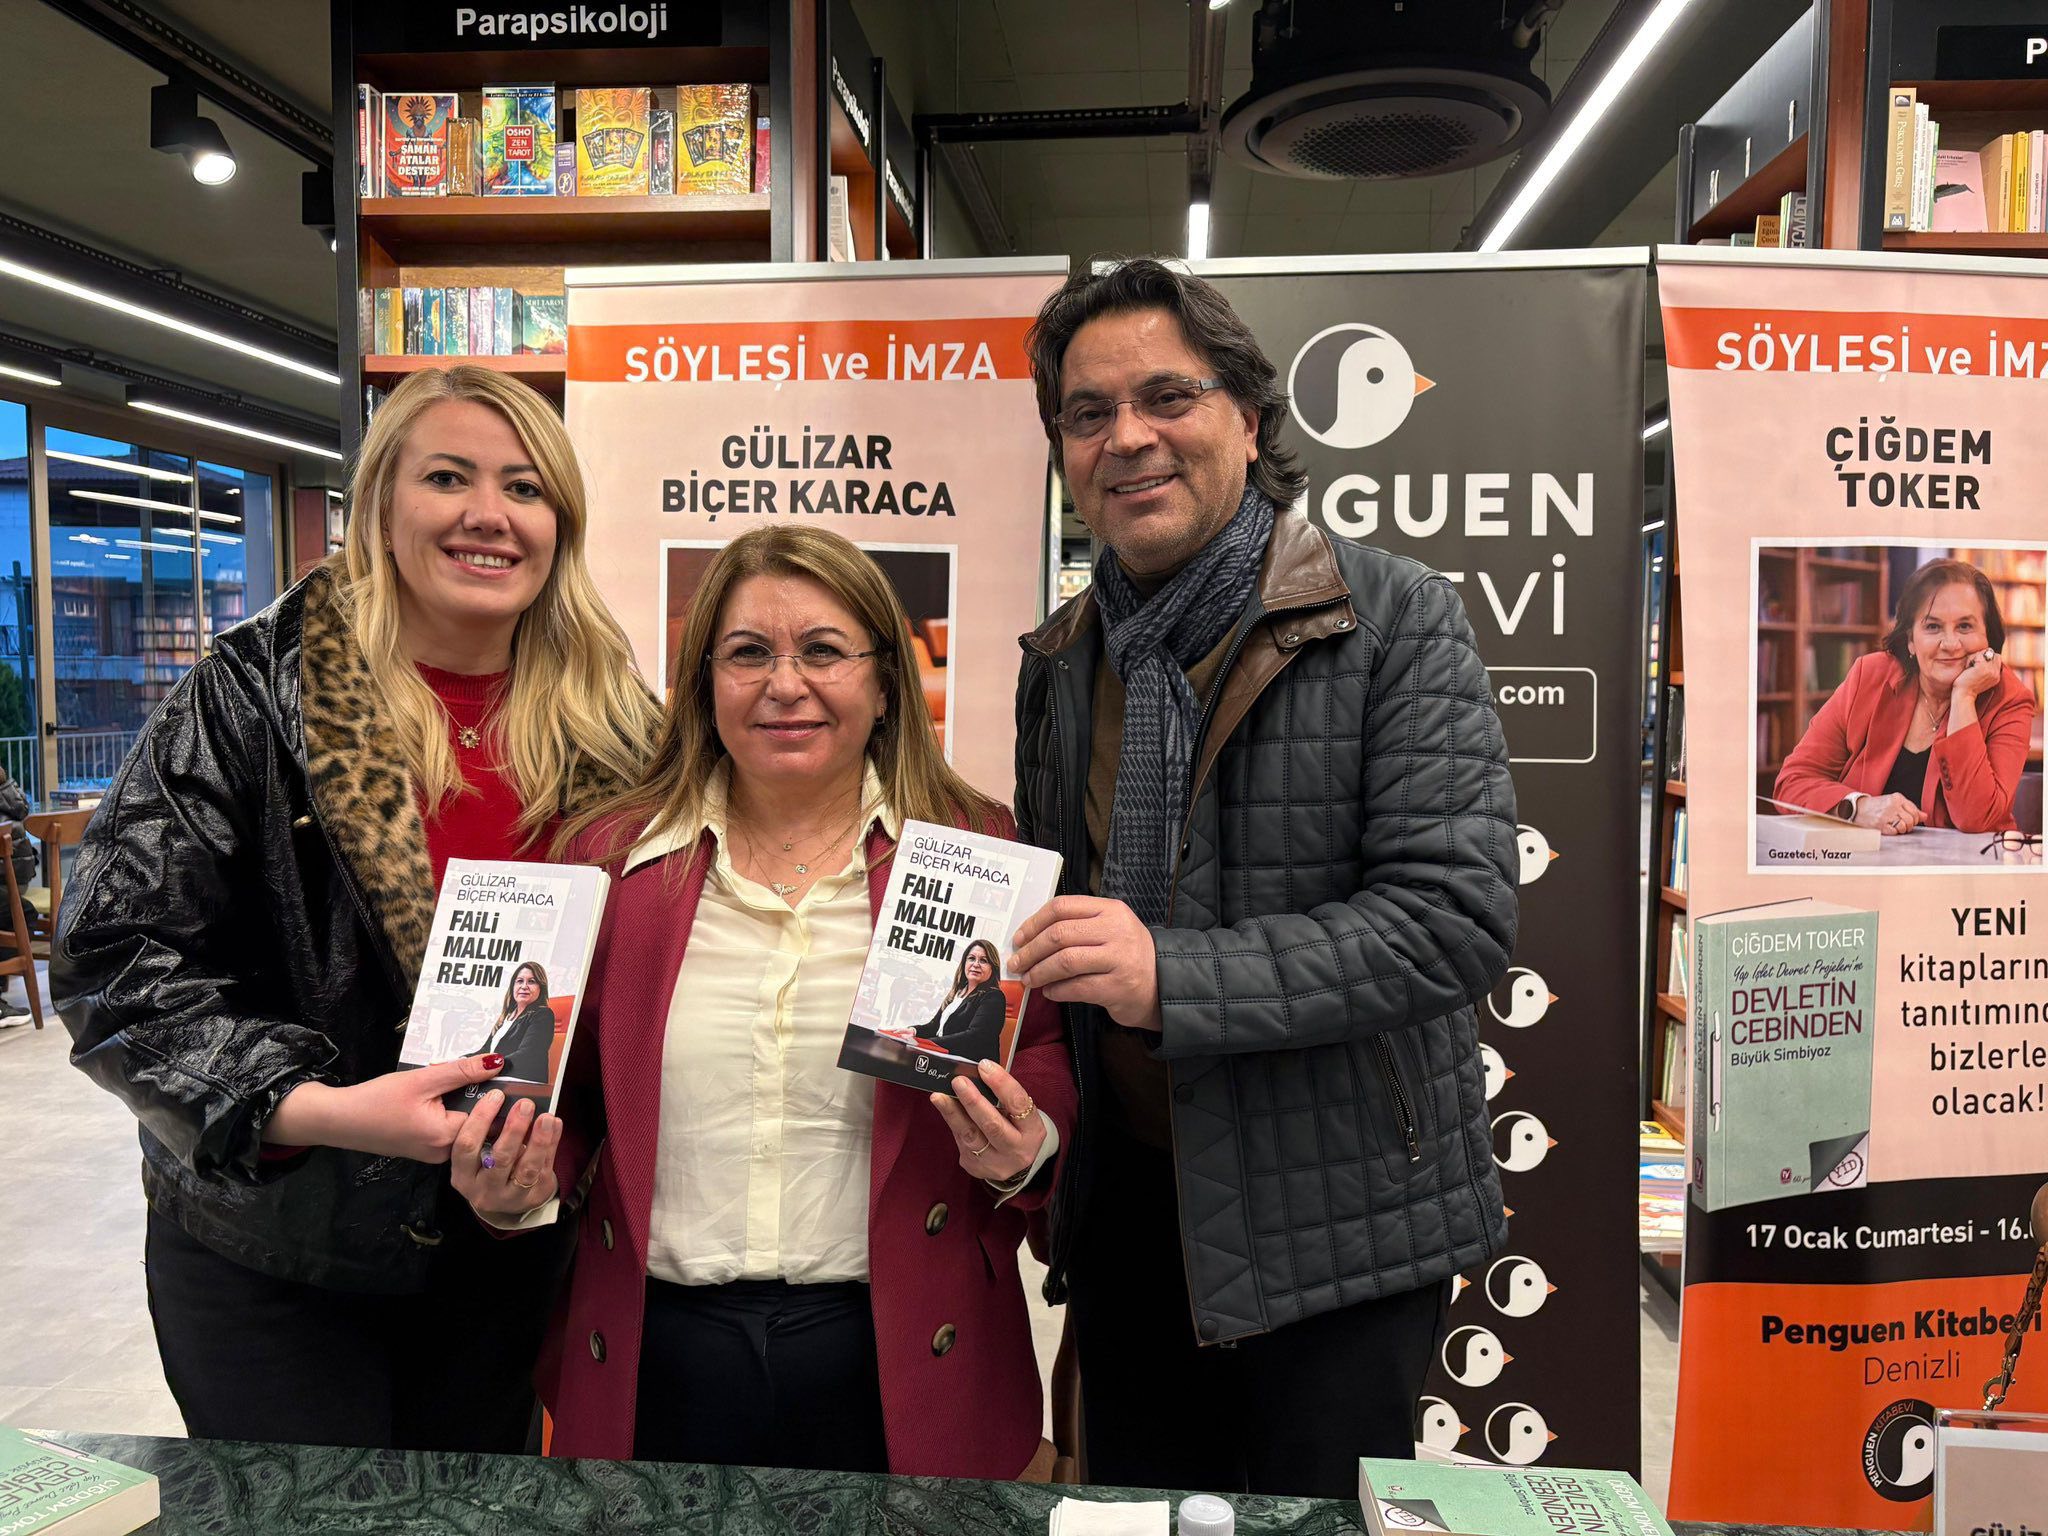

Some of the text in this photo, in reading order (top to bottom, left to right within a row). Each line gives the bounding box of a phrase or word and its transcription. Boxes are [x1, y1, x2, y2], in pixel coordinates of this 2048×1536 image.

[456, 3, 668, 41] Parapsikoloji
[2026, 37, 2048, 65] P
[506, 128, 532, 137] OSHO
[511, 139, 528, 147] ZEN
[400, 155, 439, 166] ATALAR
[401, 144, 438, 156] ŞAMAN
[508, 148, 531, 157] TAROT
[398, 165, 441, 176] DESTESİ
[625, 334, 998, 391] SÖYLEŞİ ve İMZA
[1715, 323, 1909, 382] SÖYLEŞİ
[1925, 346, 1972, 376] ve
[722, 425, 893, 470] GÜLİZAR
[1826, 416, 1992, 471] ÇİĞDEM
[662, 470, 957, 522] BİÇER KARACA
[1294, 472, 1594, 539] GUEN
[1838, 472, 1981, 510] TOKER
[914, 836, 972, 859] GÜLİZAR
[1768, 848, 1852, 861] Gazeteci, Yazar
[460, 872, 517, 888] GÜLİZAR
[910, 851, 1010, 886] BİÇER KARACA
[456, 889, 555, 907] BİÇER KARACA
[893, 898, 976, 938] MALUM
[1951, 899, 2027, 936] YENİ
[442, 935, 523, 962] MALUM
[1732, 927, 1865, 958] ÇİĞDEM TOKER
[1776, 961, 1810, 979] Devret
[1731, 976, 1857, 1016] DEVLETİN
[1730, 1009, 1863, 1046] CEBİNDEN
[1731, 1045, 1832, 1067] Büyük Simbiyoz
[1930, 1040, 2047, 1071] bizlerle
[1932, 1083, 2044, 1116] olacak!
[1833, 1158, 1858, 1179] YİD
[1746, 1224, 1777, 1248] 17
[1784, 1224, 1849, 1249] Ocak
[1855, 1220, 1974, 1249] Cumartesi
[1997, 1217, 2035, 1241] 16.
[1761, 1306, 2042, 1352] Penguen Kitabei
[1864, 1350, 1961, 1385] Denizli
[1864, 1431, 1883, 1488] PENGUEN
[1523, 1474, 1581, 1535] CEBİNDEN
[1551, 1476, 1610, 1534] DEVLETİN
